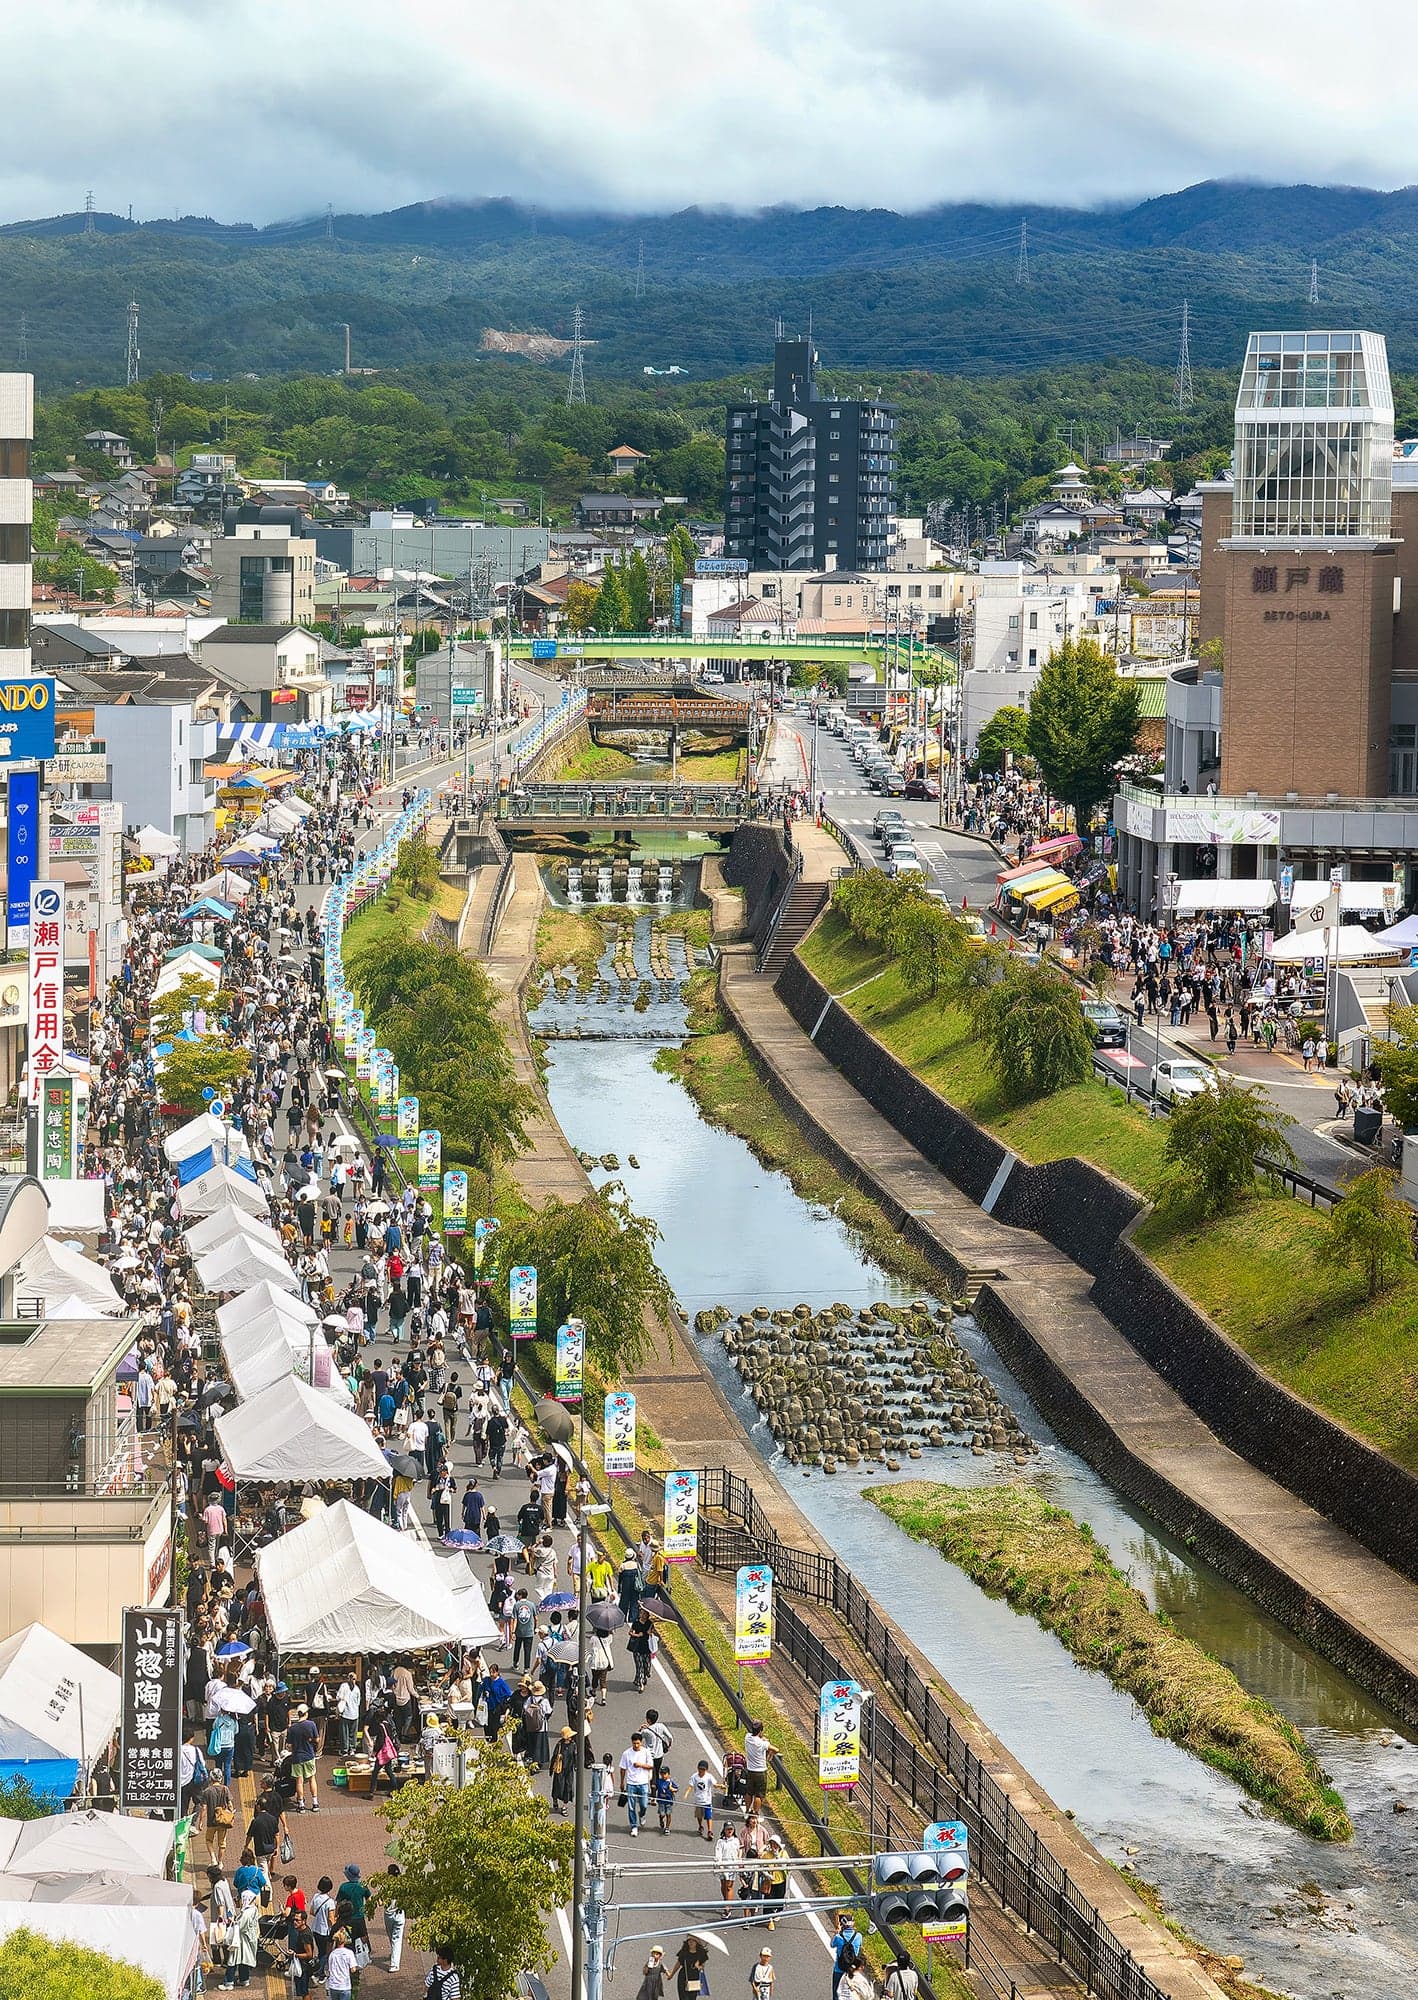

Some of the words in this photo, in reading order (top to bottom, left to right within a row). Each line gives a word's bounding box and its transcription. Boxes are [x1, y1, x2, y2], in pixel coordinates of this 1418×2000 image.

[1253, 566, 1344, 593] 瀬戸蔵
[33, 921, 60, 1100] 瀬戸信用金
[517, 1278, 535, 1316] せともの祭
[565, 1338, 582, 1379] せともの祭
[614, 1397, 627, 1406] 祝
[614, 1407, 633, 1451] せともの祭
[675, 1476, 689, 1486] 祝
[672, 1487, 695, 1534] せともの祭
[748, 1570, 763, 1581] 祝
[745, 1582, 768, 1634] せともの祭
[134, 1617, 163, 1740] 山惣陶器
[833, 1686, 850, 1698] 祝
[830, 1699, 857, 1755] せともの祭
[127, 1748, 173, 1759] 営業食器
[128, 1760, 173, 1769] くらしの器
[127, 1779, 173, 1790] たくみ工房
[937, 1828, 955, 1842] 祝
